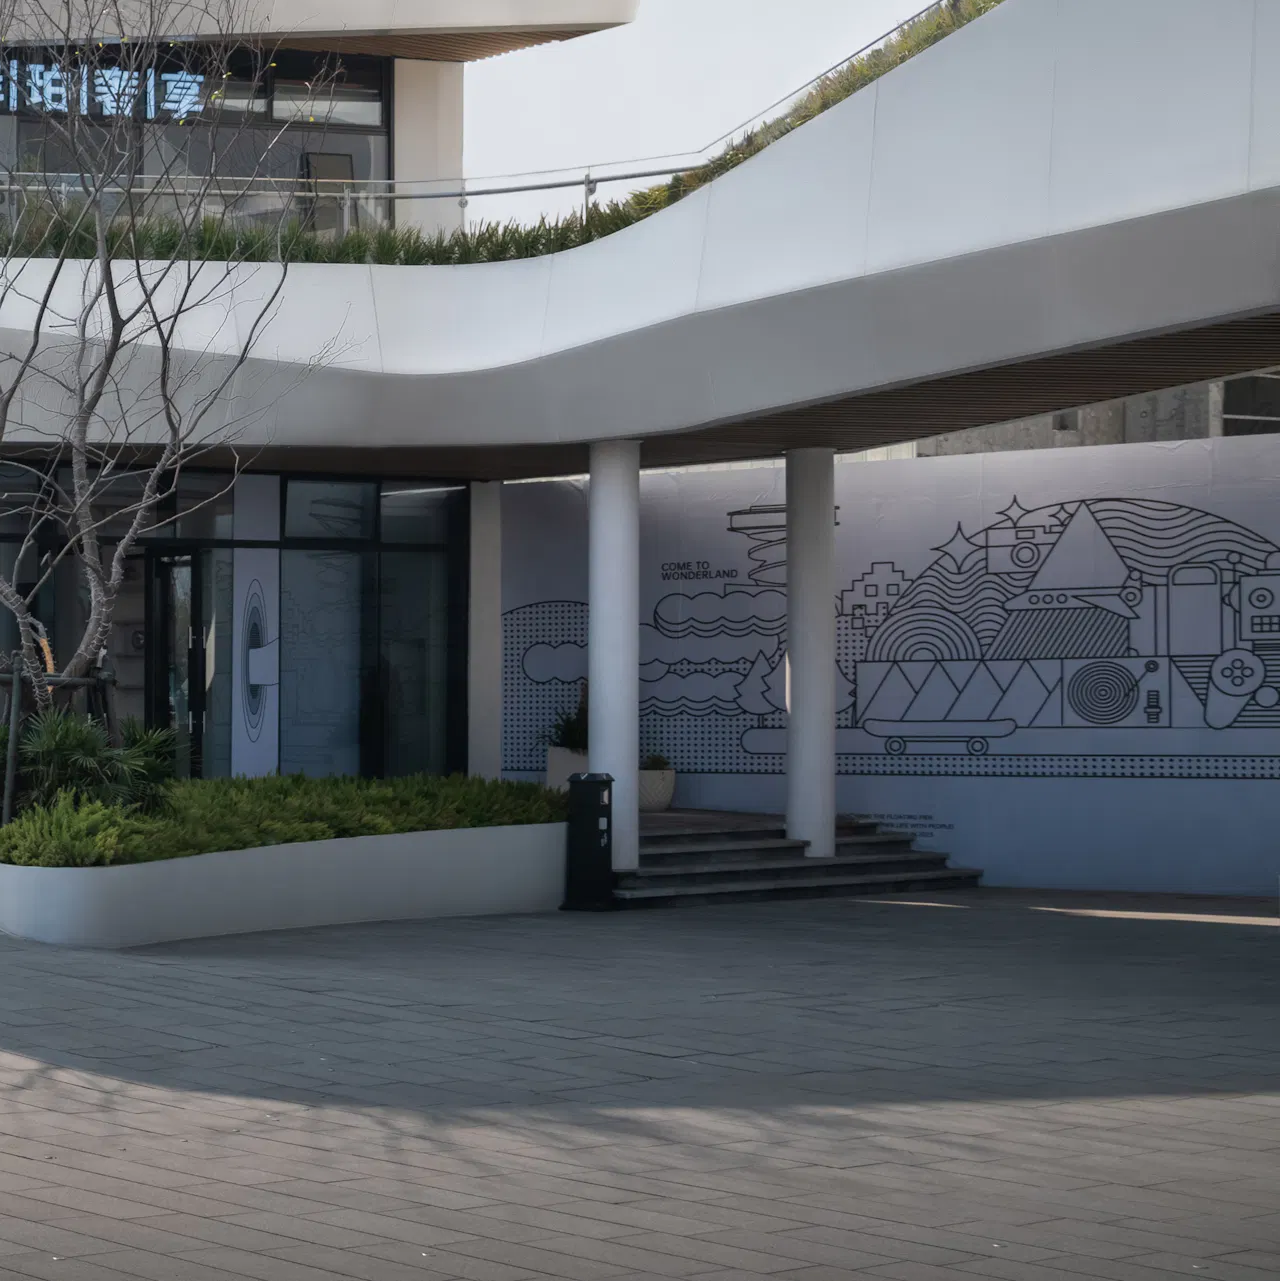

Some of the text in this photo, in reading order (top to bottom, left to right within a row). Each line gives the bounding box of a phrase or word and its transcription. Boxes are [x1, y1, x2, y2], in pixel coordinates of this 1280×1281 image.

[661, 561, 710, 571] COME TO
[661, 569, 738, 580] WONDERLAND
